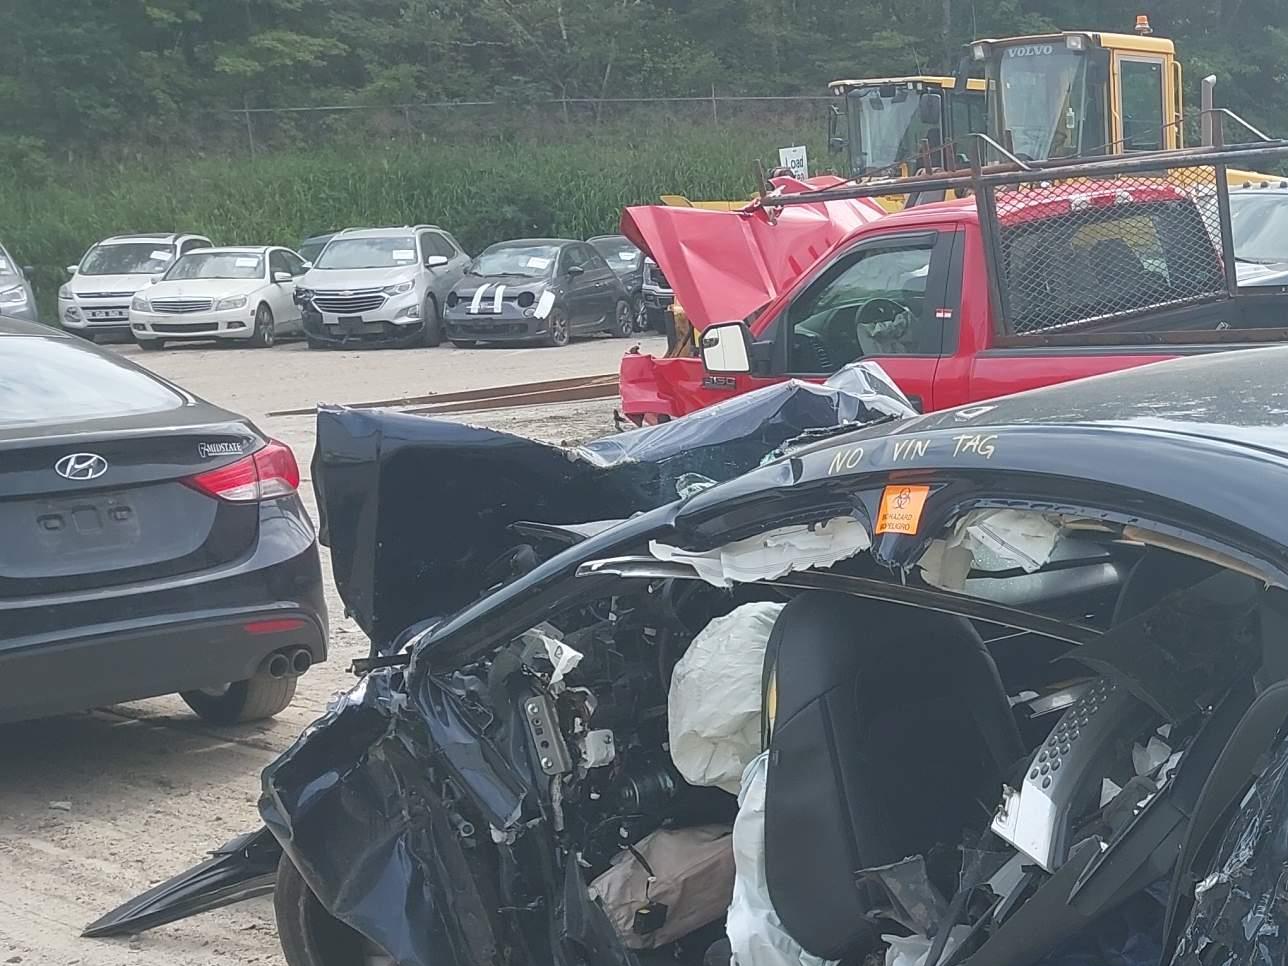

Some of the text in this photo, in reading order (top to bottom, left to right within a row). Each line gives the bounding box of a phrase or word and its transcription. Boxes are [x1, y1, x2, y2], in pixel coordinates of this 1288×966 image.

[1007, 44, 1053, 58] VOLVO
[206, 442, 242, 453] MIDSTATE
[828, 434, 998, 476] NO VIN TAG
